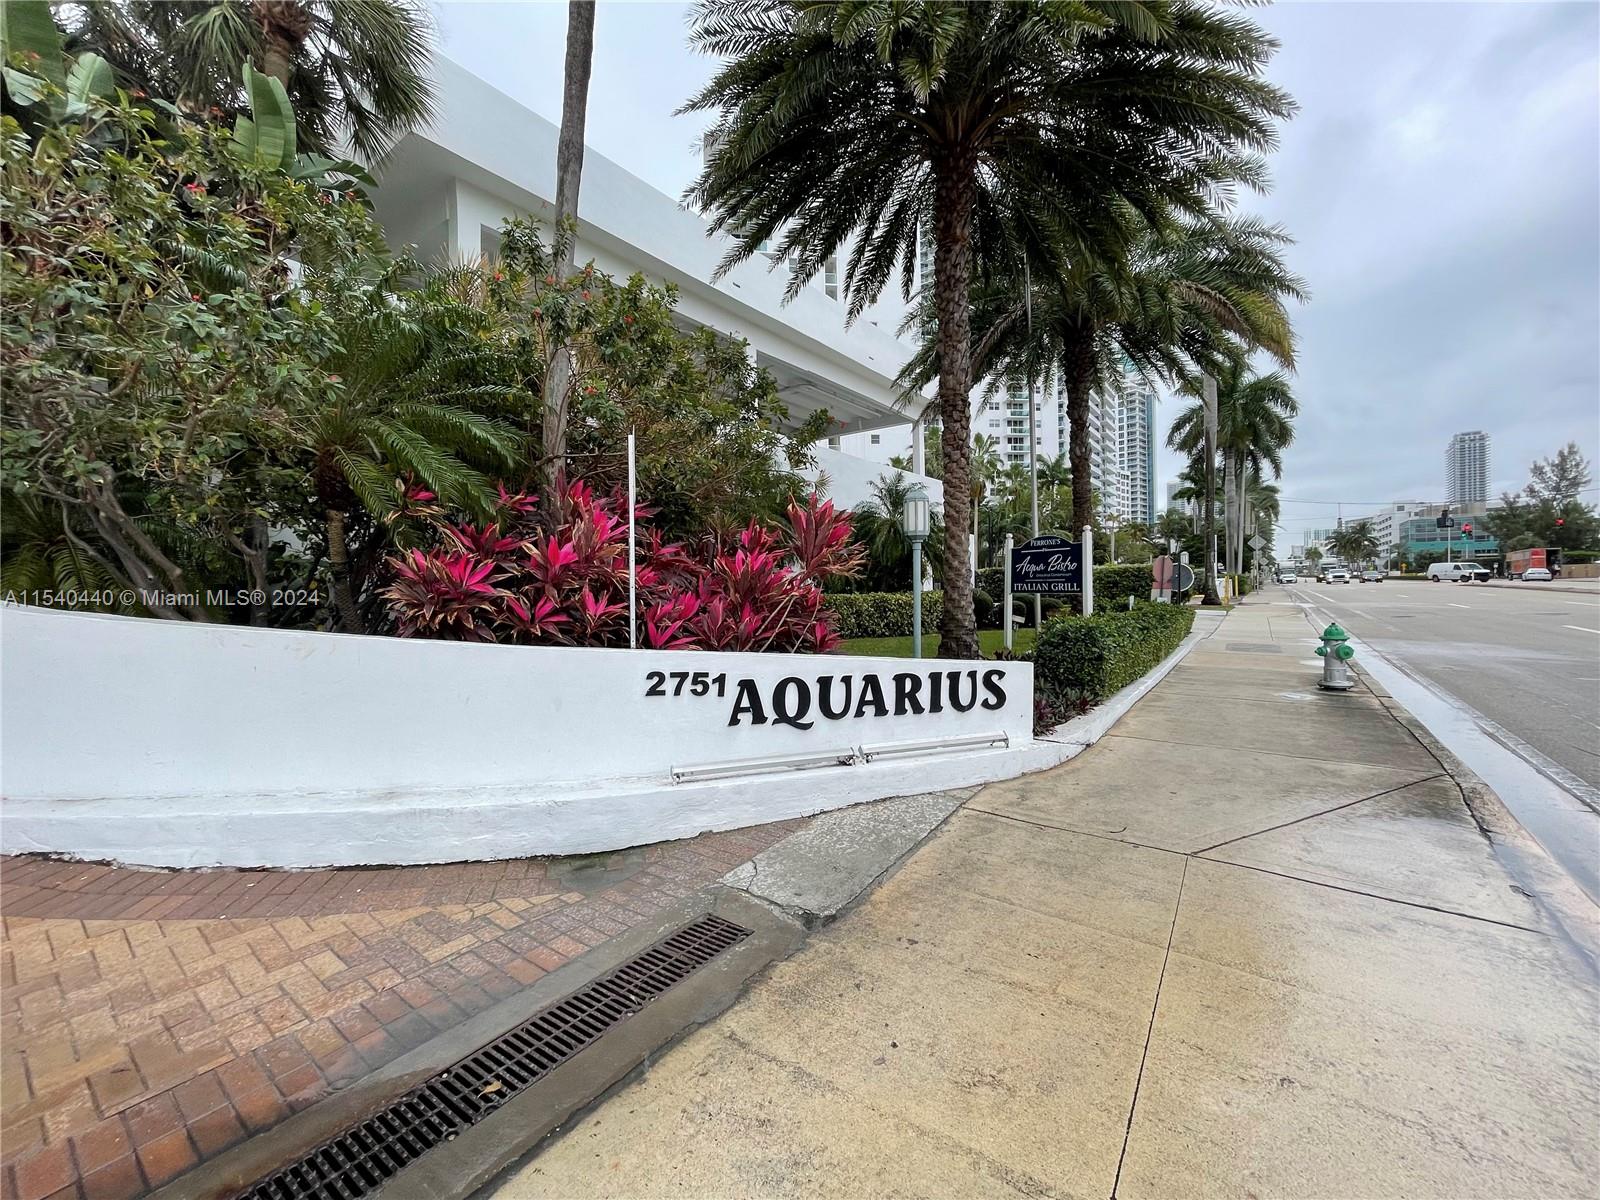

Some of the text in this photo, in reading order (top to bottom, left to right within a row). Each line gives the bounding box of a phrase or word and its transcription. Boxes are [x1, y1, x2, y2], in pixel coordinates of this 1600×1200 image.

[1015, 553, 1078, 578] Acqua Bistro
[1014, 582, 1080, 591] ITALIAN GRILL
[645, 669, 1006, 731] 2751 AQUARIUS
